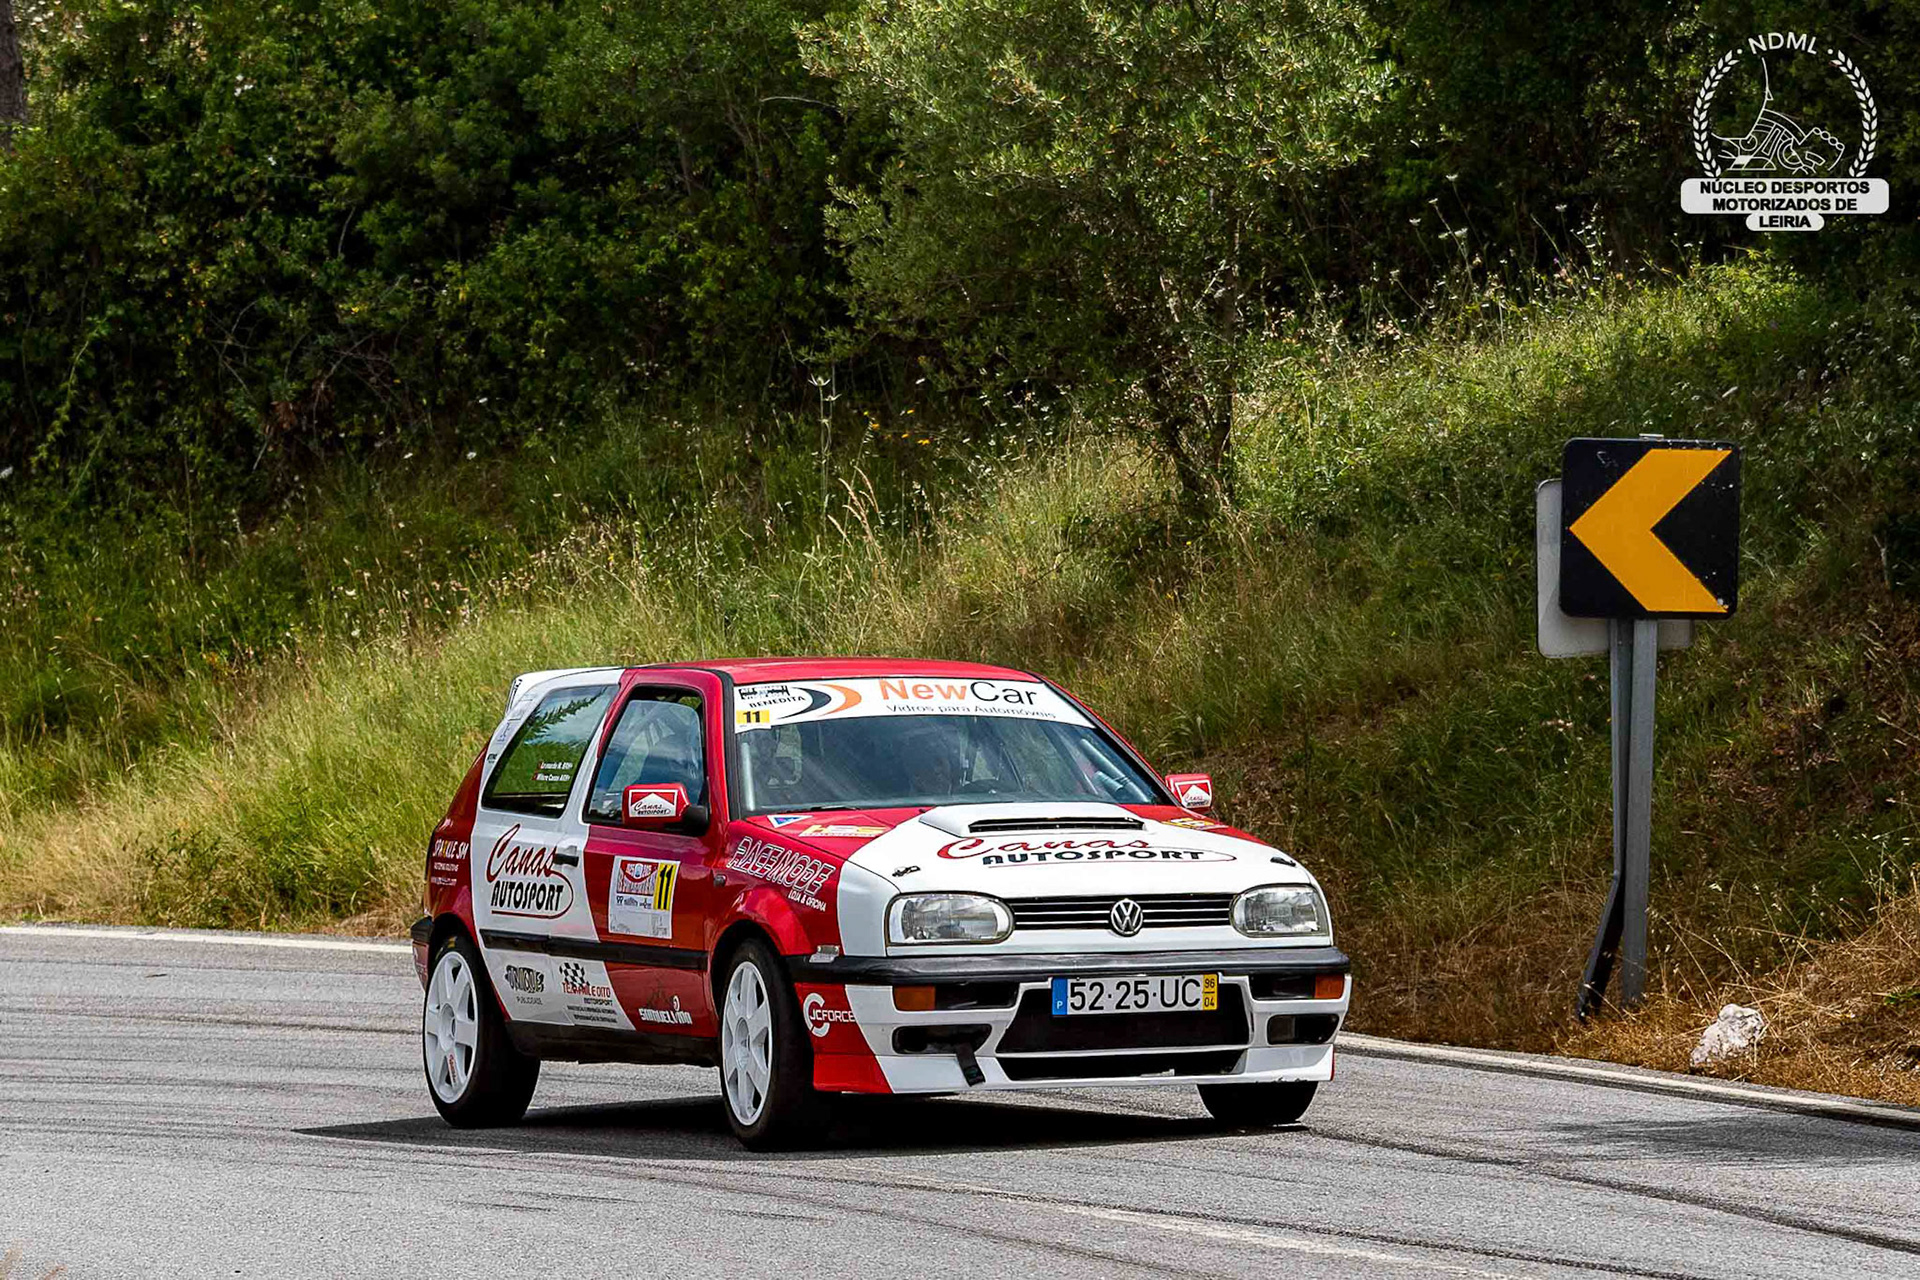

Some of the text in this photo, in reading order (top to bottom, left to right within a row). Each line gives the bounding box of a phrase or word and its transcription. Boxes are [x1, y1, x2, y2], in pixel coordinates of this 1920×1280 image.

[749, 696, 806, 708] BENEDITA
[743, 711, 760, 723] 11
[886, 704, 1057, 718] Vidros para Automóveis
[634, 802, 662, 811] Canas
[486, 823, 558, 882] Canas
[937, 837, 1149, 859] Canas
[982, 850, 1204, 865] AUTOSPORT
[658, 865, 674, 910] 11
[491, 880, 564, 911] AUTOSPORT
[788, 889, 802, 902] LOJA
[806, 897, 827, 912] OFICINA
[1205, 978, 1215, 989] 96
[1056, 1001, 1063, 1009] P
[1204, 997, 1215, 1008] 04
[809, 1009, 856, 1022] JCFORCE
